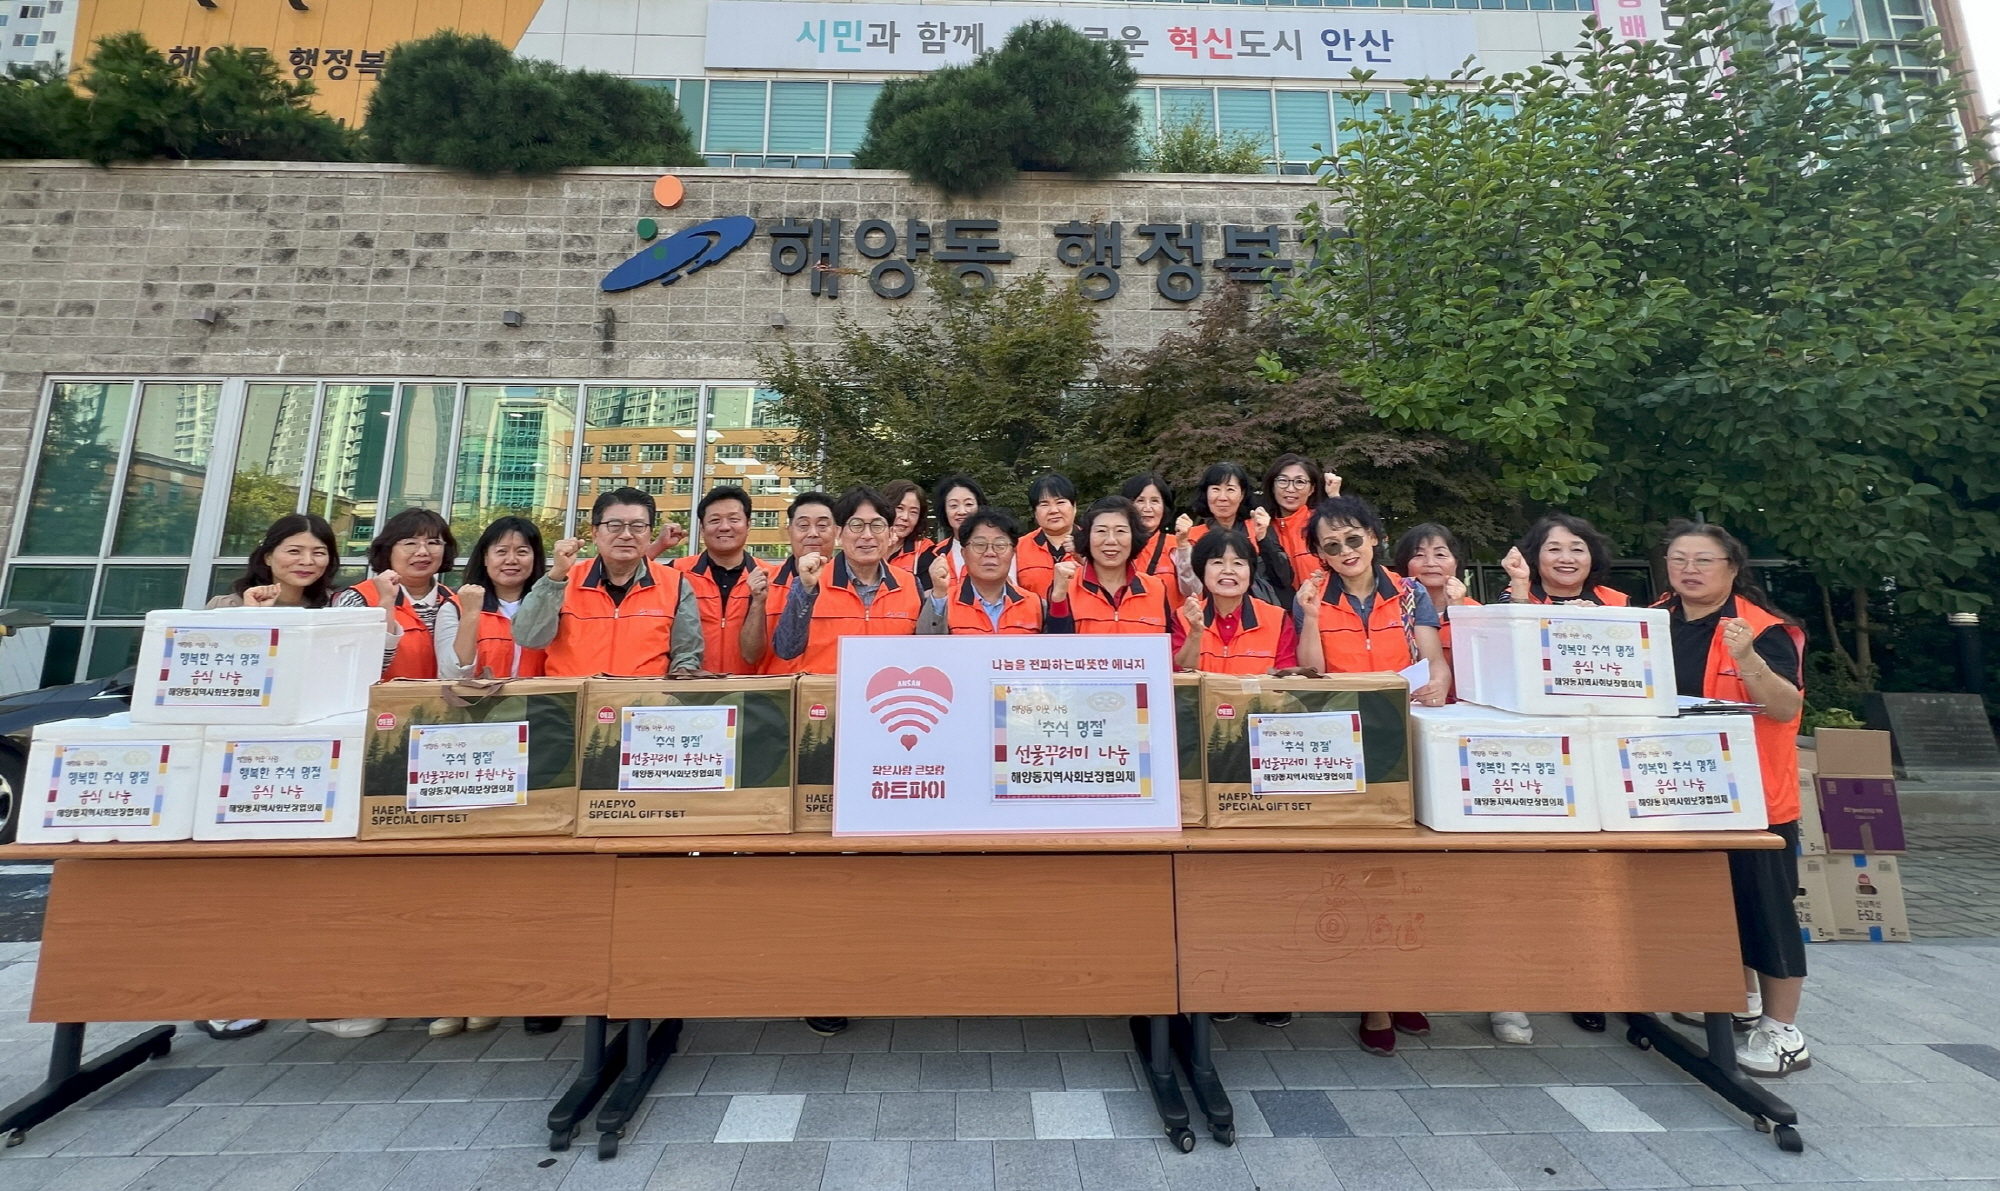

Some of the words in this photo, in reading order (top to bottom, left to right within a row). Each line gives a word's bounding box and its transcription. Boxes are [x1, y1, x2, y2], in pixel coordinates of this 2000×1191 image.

[795, 19, 901, 54] 시민과
[1166, 26, 1303, 61] 혁신도시
[1320, 28, 1394, 63] 안산
[769, 217, 1014, 299] 해양동
[1557, 644, 1586, 656] 행복한
[1591, 645, 1610, 656] 추석
[1616, 645, 1634, 658] 명절
[180, 653, 209, 665] 행복한
[215, 654, 234, 665] 추석
[240, 654, 260, 666] 명절
[992, 659, 1026, 671] 나눔을
[1029, 659, 1109, 671] 전파하는따뜻한
[1112, 659, 1145, 670] 에너지
[1573, 660, 1594, 674] 음식
[1600, 662, 1622, 676] 나눔
[190, 670, 213, 685] 음식
[220, 671, 243, 685] 나눔
[631, 753, 677, 766] 선물꾸러미
[1015, 744, 1088, 766] 선물꾸러미
[872, 765, 912, 775] 작은사랑
[1261, 758, 1308, 770] 선물꾸러미
[1476, 762, 1505, 774] 행복한
[1511, 762, 1530, 774] 추석
[1535, 762, 1555, 775] 명절
[1638, 762, 1667, 775] 행복한
[1673, 761, 1692, 773] 추석
[1697, 759, 1717, 773] 명절
[68, 772, 98, 785] 행복한
[103, 772, 124, 784] 추석
[130, 771, 149, 784] 명절
[240, 767, 270, 780] 행복한
[275, 767, 295, 779] 추석
[301, 766, 321, 780] 명절
[419, 770, 469, 784] 선물꾸러미
[251, 785, 274, 800] 음식
[281, 785, 304, 799] 나눔
[872, 780, 945, 799] 하트파이
[1492, 778, 1514, 794] 음식
[1520, 779, 1543, 794] 나눔
[1655, 779, 1677, 794] 음식
[1683, 778, 1706, 792] 나눔
[79, 789, 103, 805] 음식
[109, 789, 132, 805] 나눔
[590, 800, 636, 808] HAEPYO
[1218, 802, 1264, 811] SPECIAL
[1292, 802, 1312, 810] SET
[372, 816, 419, 825] SPECIAL
[421, 815, 445, 824] GIFT
[447, 814, 468, 823] SET
[589, 810, 637, 819] SPECIAL
[639, 810, 662, 818] GIFT
[665, 810, 686, 818] SET
